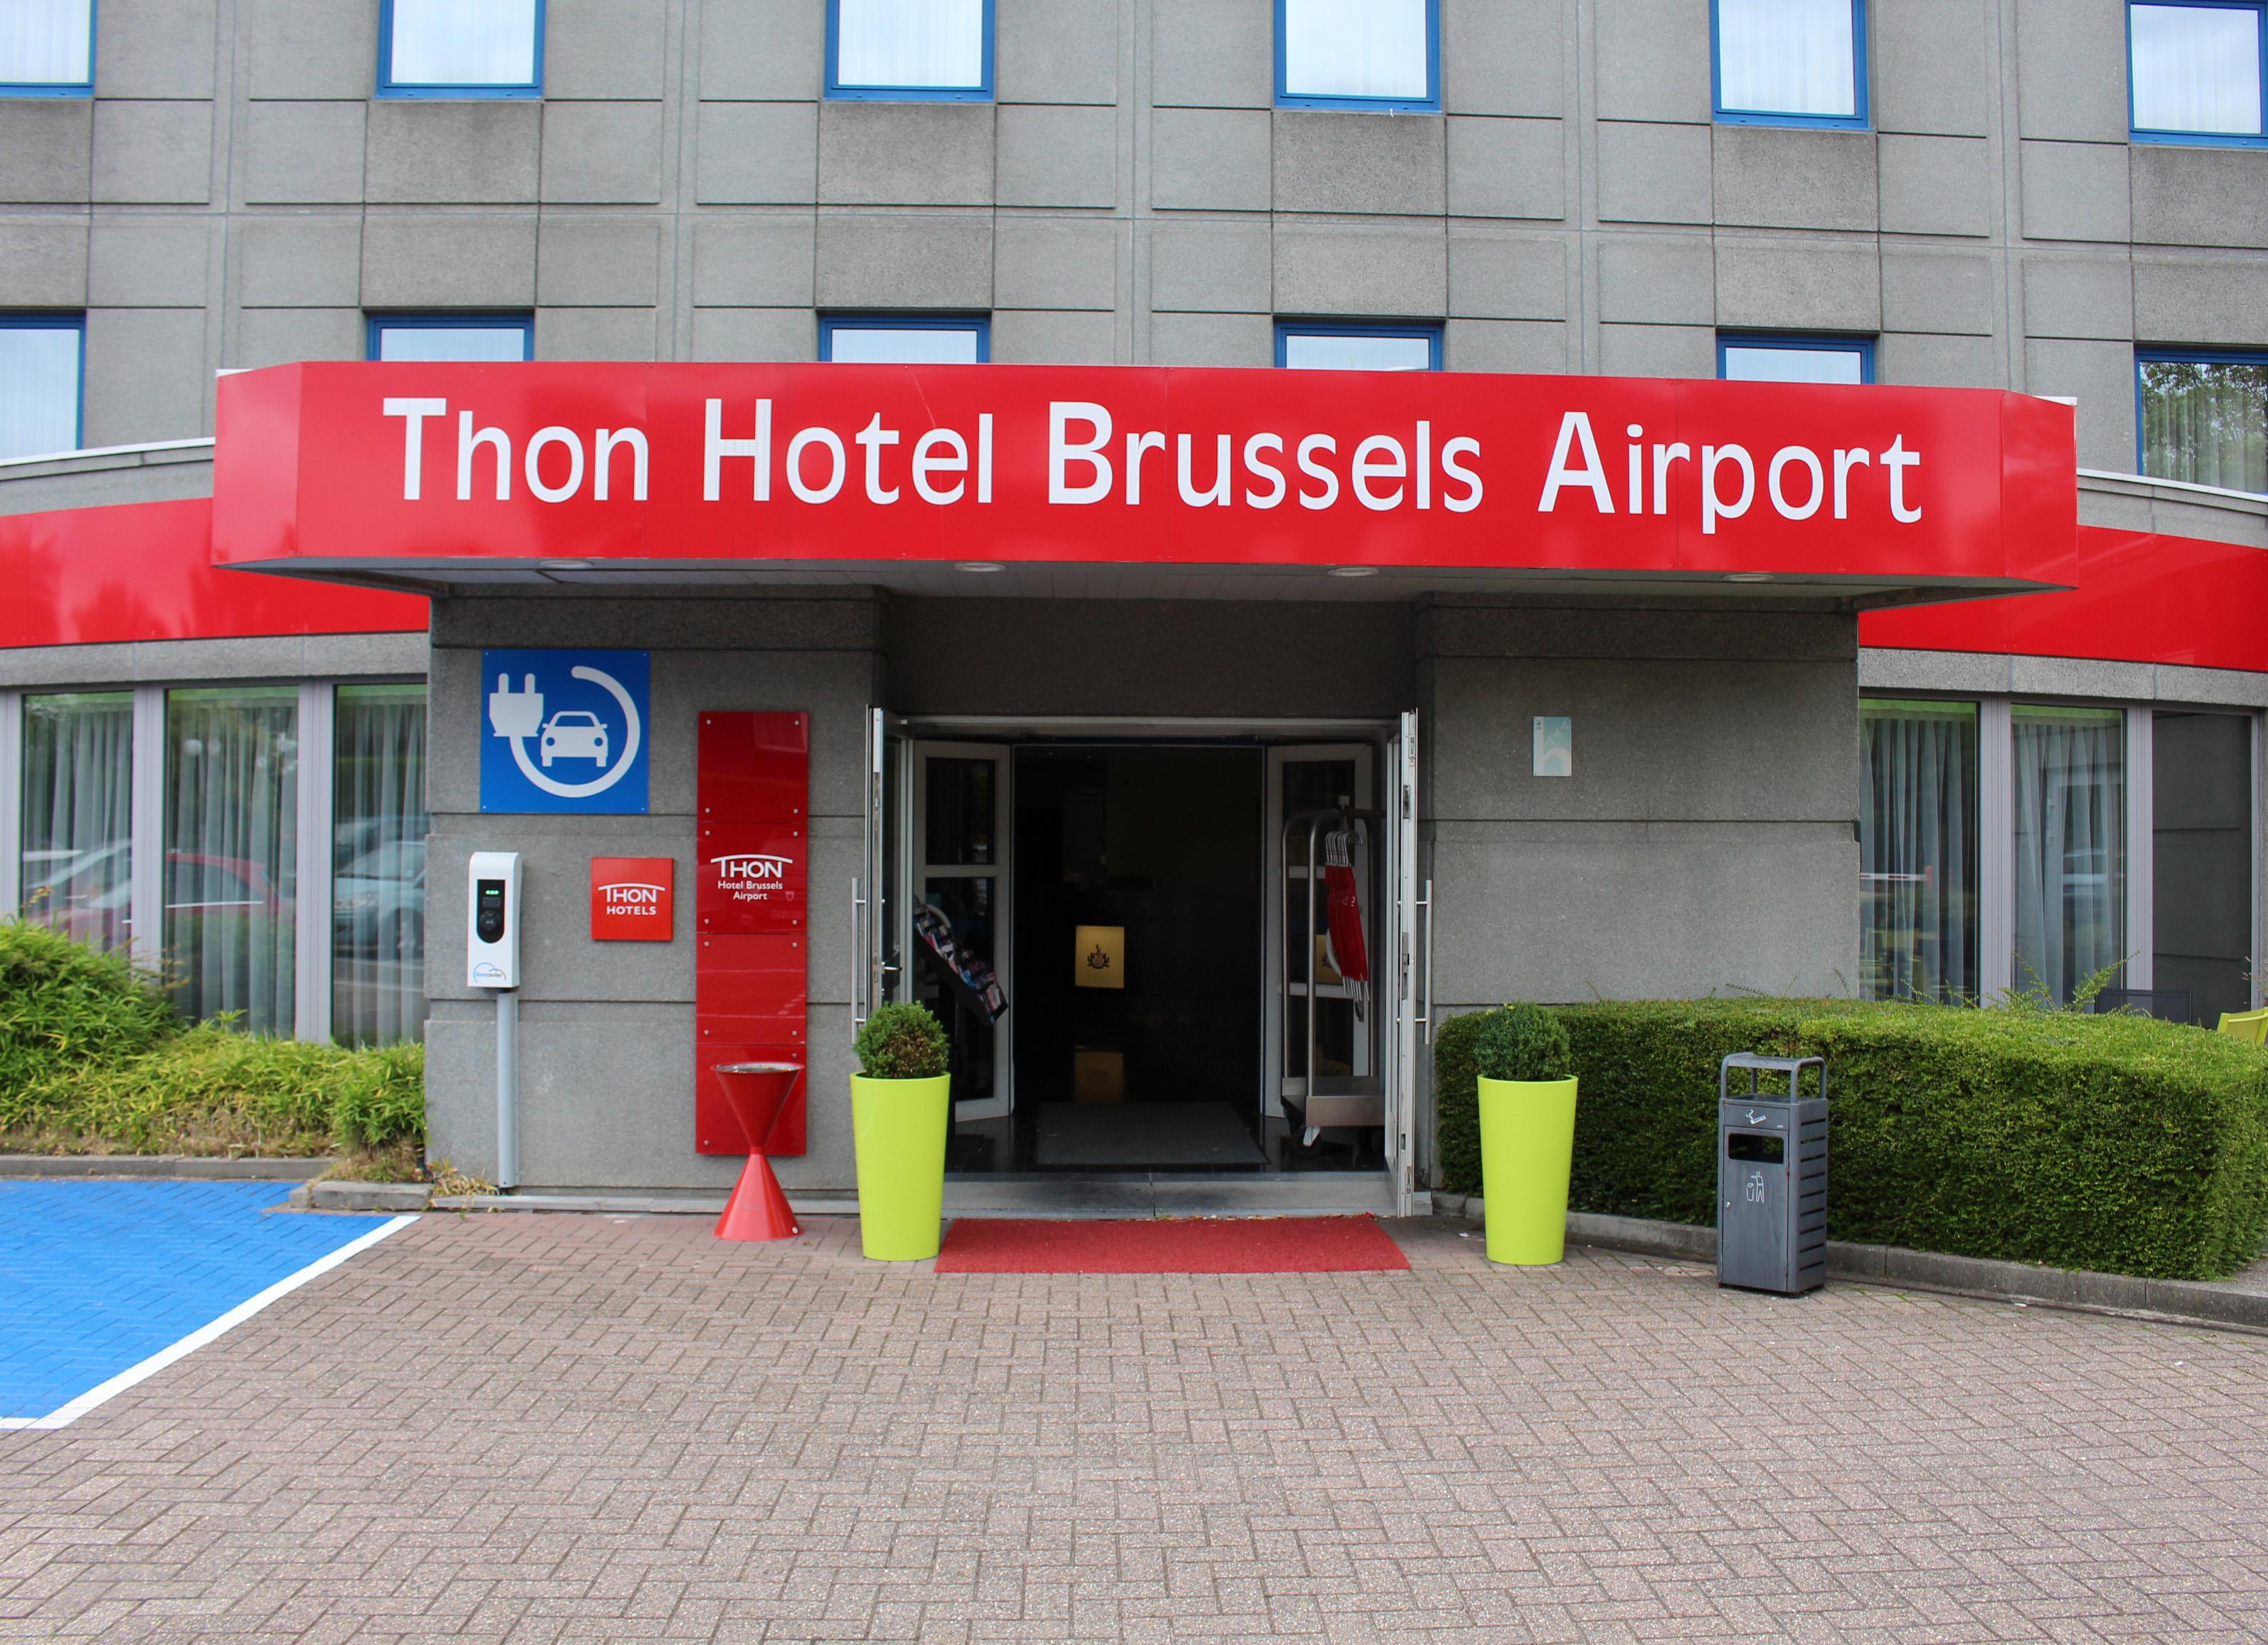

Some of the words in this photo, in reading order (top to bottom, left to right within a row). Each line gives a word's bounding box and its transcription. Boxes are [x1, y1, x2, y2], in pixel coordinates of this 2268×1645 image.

[383, 398, 648, 503] Thon
[703, 398, 993, 505] Hotel
[1049, 402, 1482, 512] Brussels
[1538, 412, 1922, 534] Airport
[710, 854, 793, 878] THON
[598, 882, 666, 903] THON
[718, 880, 744, 890] Hotel
[746, 880, 783, 890] Brussels
[733, 890, 768, 902] Airport
[606, 905, 657, 915] HOTELS
